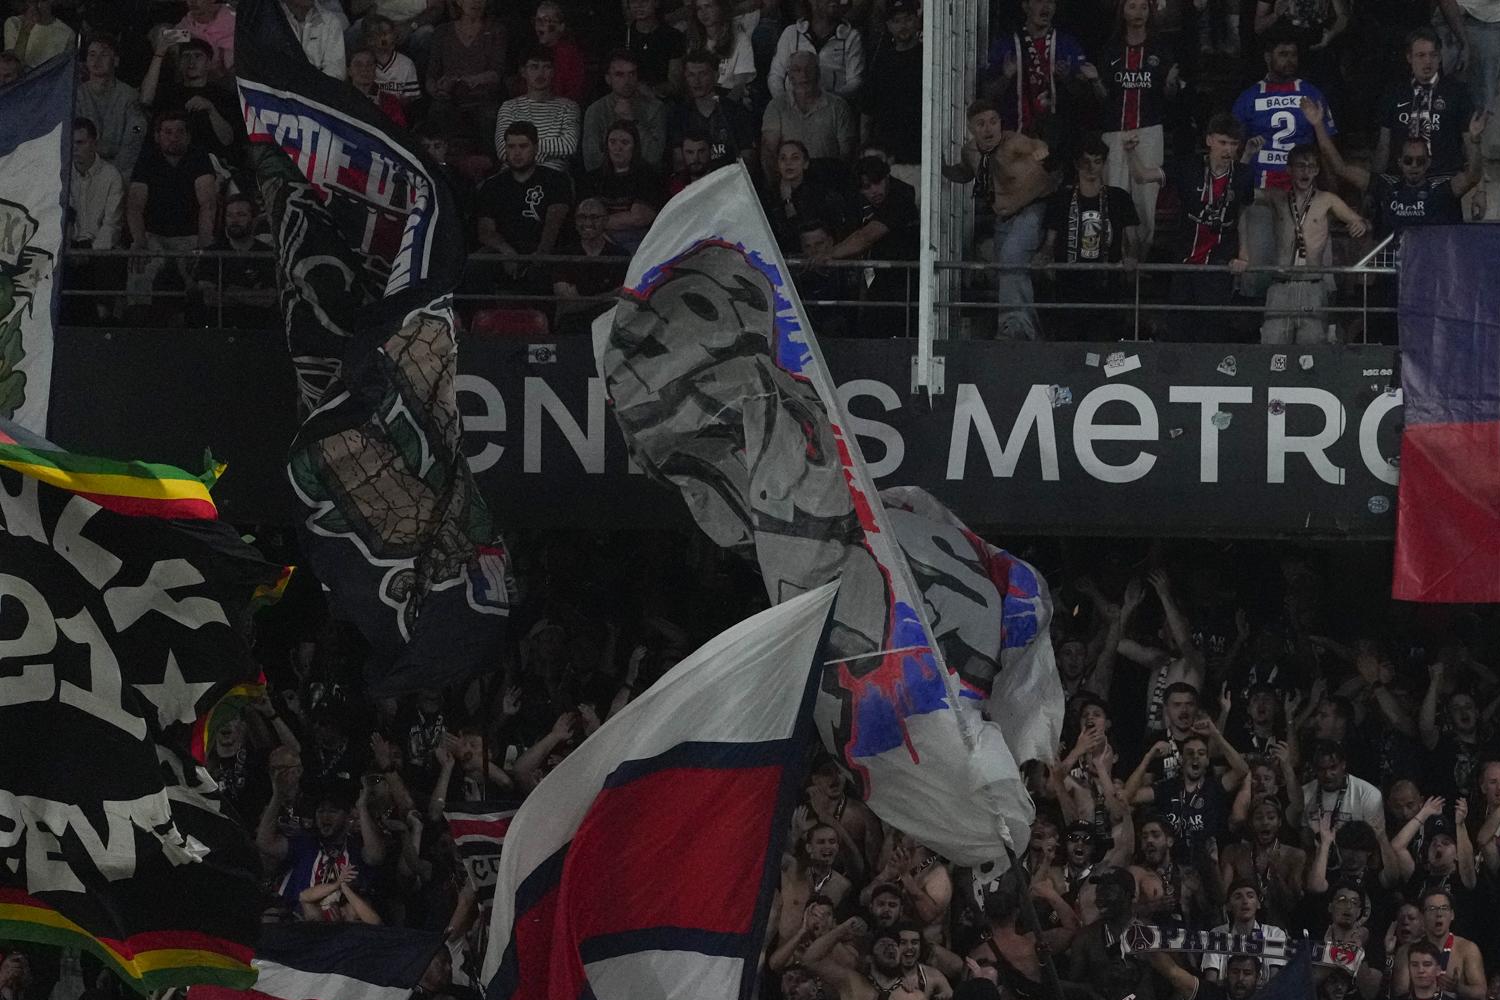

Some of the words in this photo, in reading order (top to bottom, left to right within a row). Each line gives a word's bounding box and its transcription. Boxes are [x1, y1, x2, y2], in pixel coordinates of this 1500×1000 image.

[1114, 71, 1151, 83] QATAR
[1270, 111, 1297, 151] 2
[1267, 153, 1290, 163] BAC
